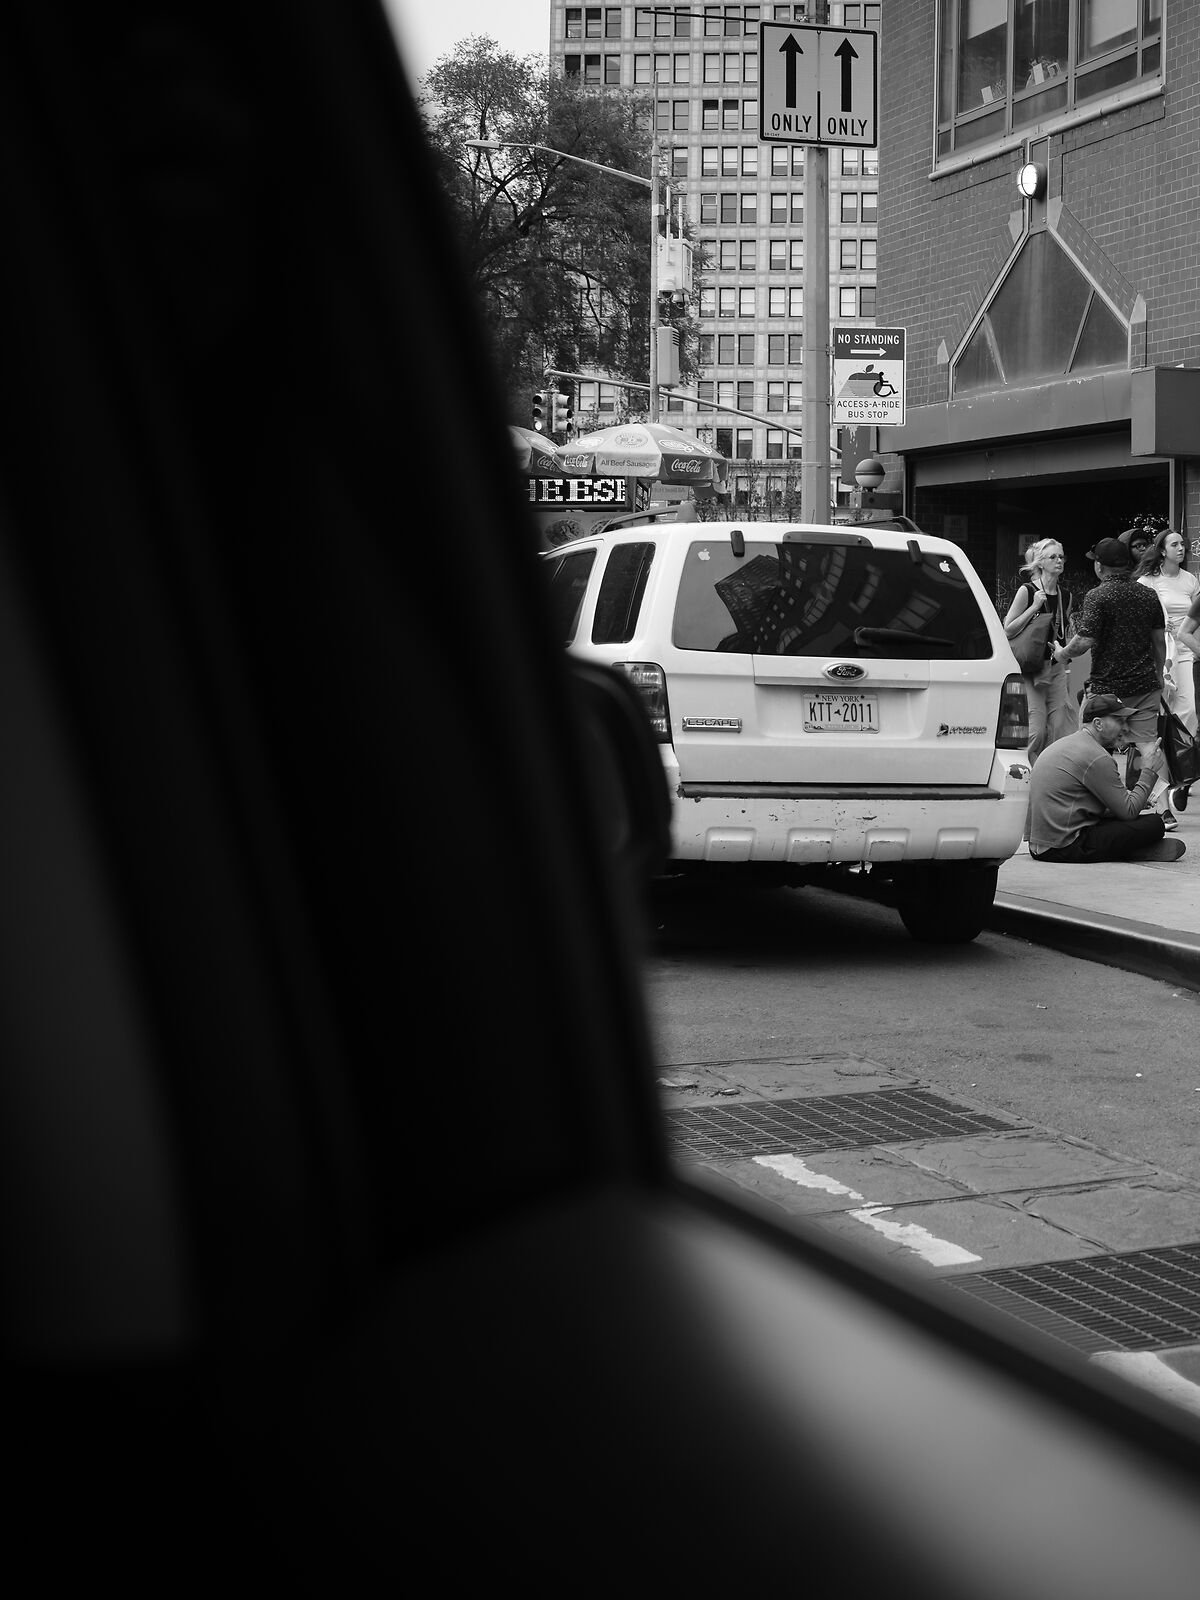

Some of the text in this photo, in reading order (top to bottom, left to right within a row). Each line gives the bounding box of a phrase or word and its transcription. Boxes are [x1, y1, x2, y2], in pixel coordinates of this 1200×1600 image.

[771, 113, 812, 133] ONLY
[827, 117, 868, 137] ONLY
[838, 334, 900, 345] NO STANDING
[837, 400, 900, 409] ACCESS-A-RIDE
[848, 411, 889, 419] BUS STOP
[601, 459, 657, 469] All Beef Sausages
[836, 666, 857, 676] Ford
[840, 695, 860, 703] YORK
[809, 702, 872, 723] KTT 2011
[688, 718, 738, 727] ESCAPE
